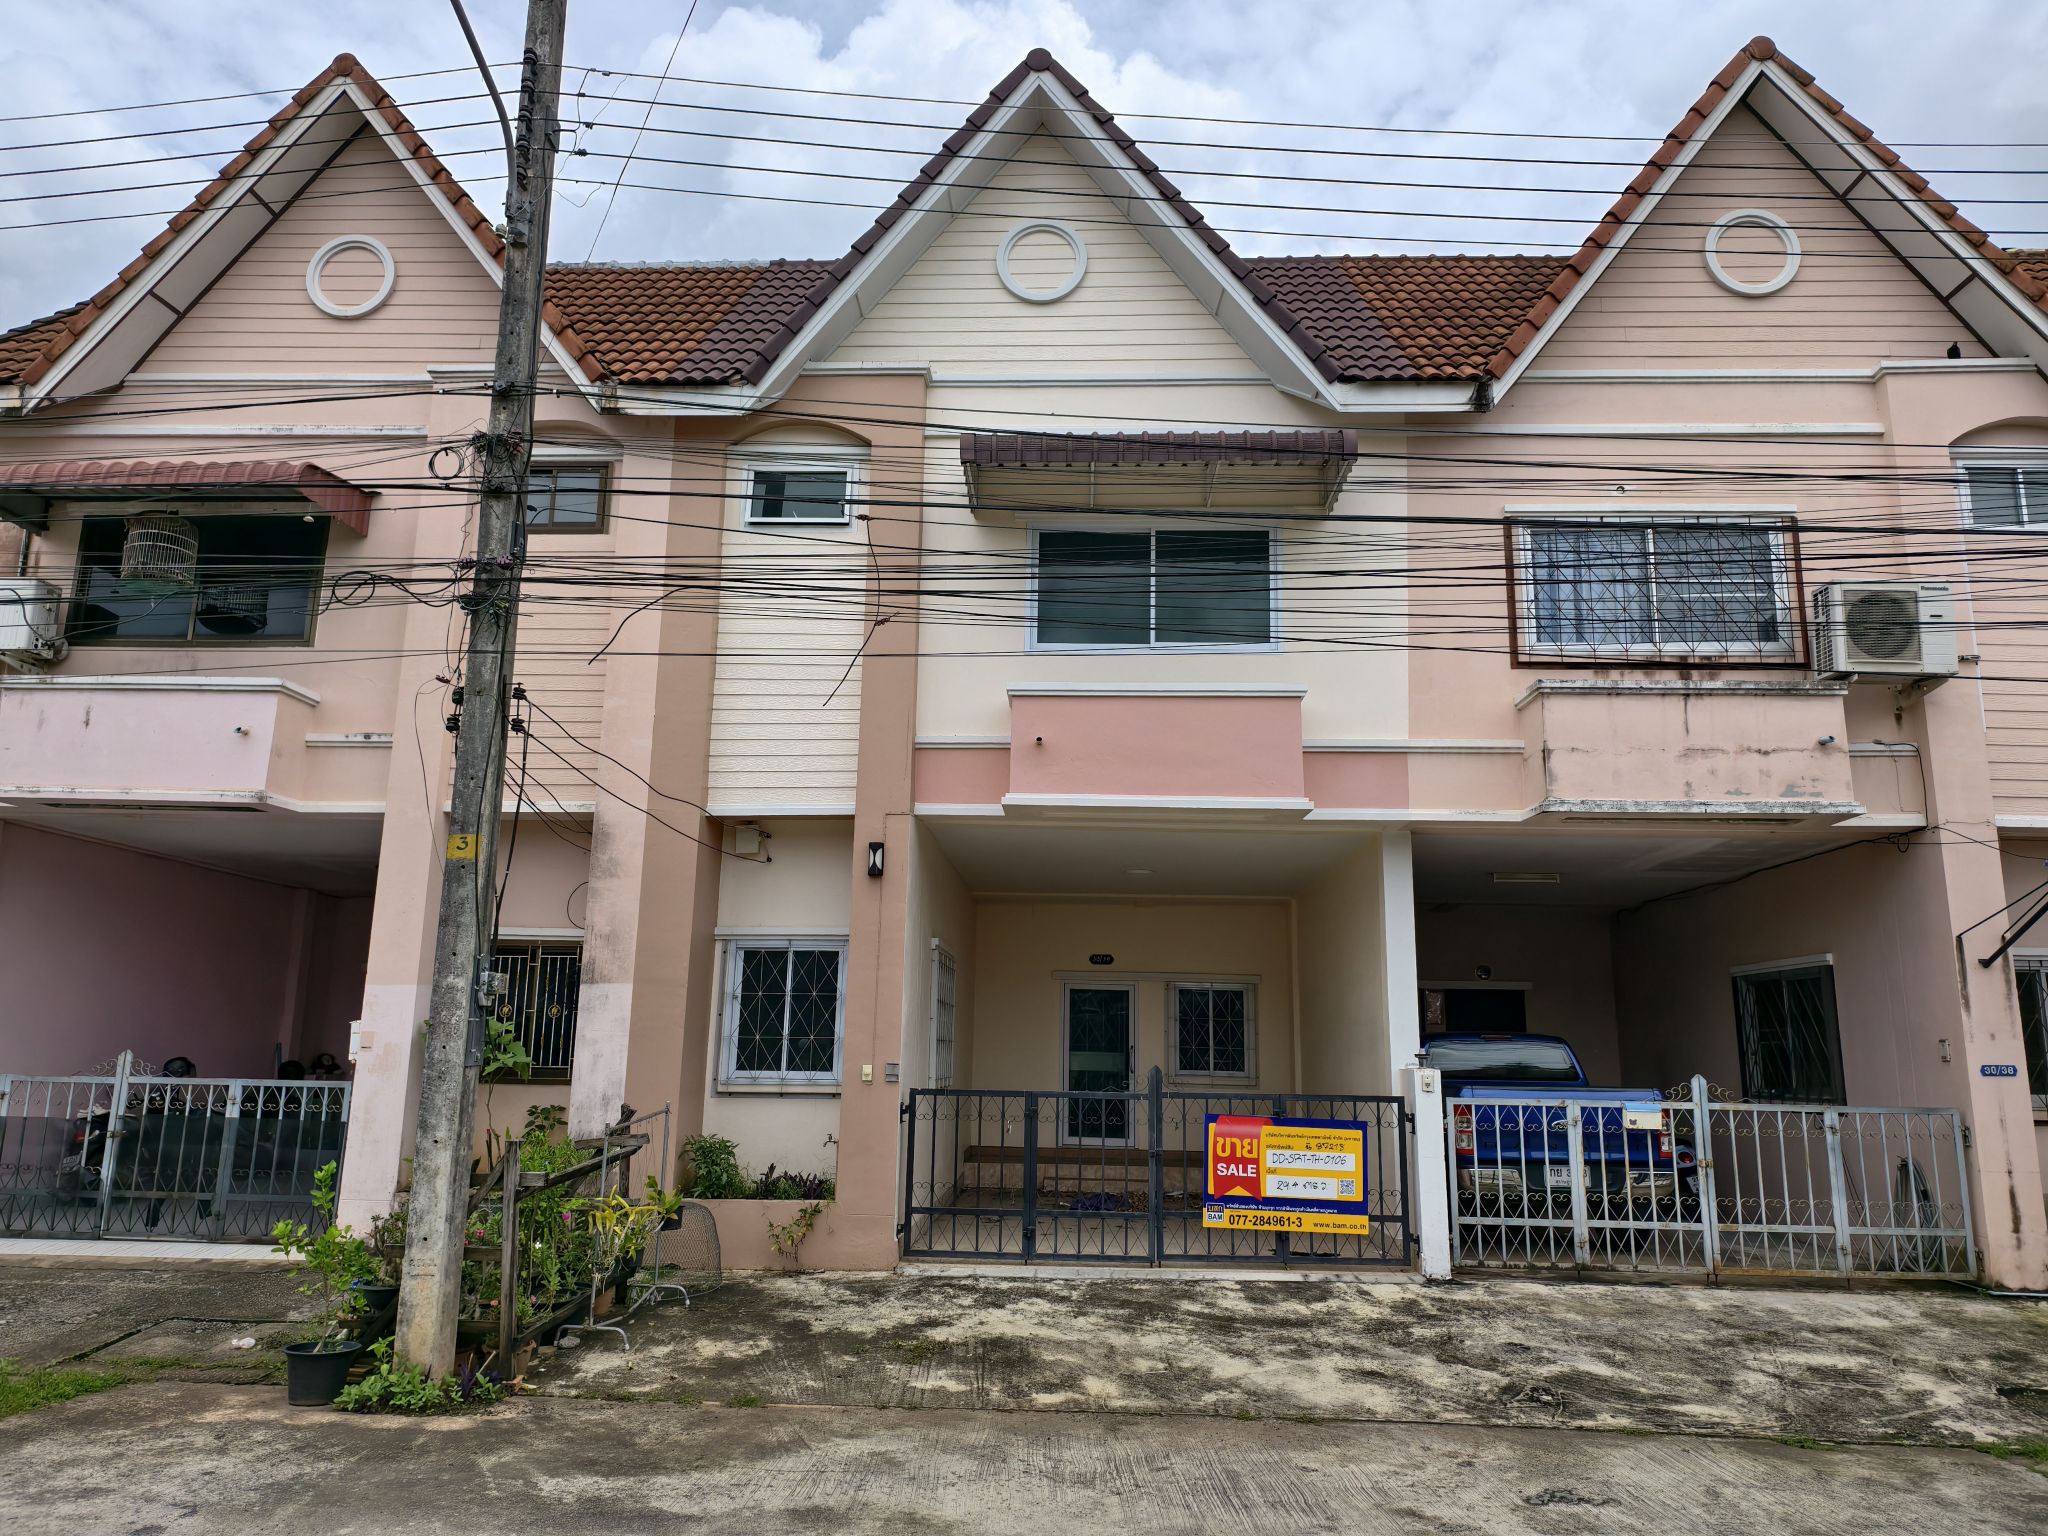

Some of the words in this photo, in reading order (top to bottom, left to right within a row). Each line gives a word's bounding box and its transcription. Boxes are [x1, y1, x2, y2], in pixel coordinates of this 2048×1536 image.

[456, 836, 469, 851] 3
[1984, 1066, 2014, 1076] 30/38
[1216, 1136, 1259, 1159] ขาย
[1216, 1162, 1257, 1178] SALE
[1207, 1212, 1223, 1222] BAM
[1228, 1214, 1303, 1228] 077-284961-3
[1312, 1221, 1367, 1230] www.bam.co.th
